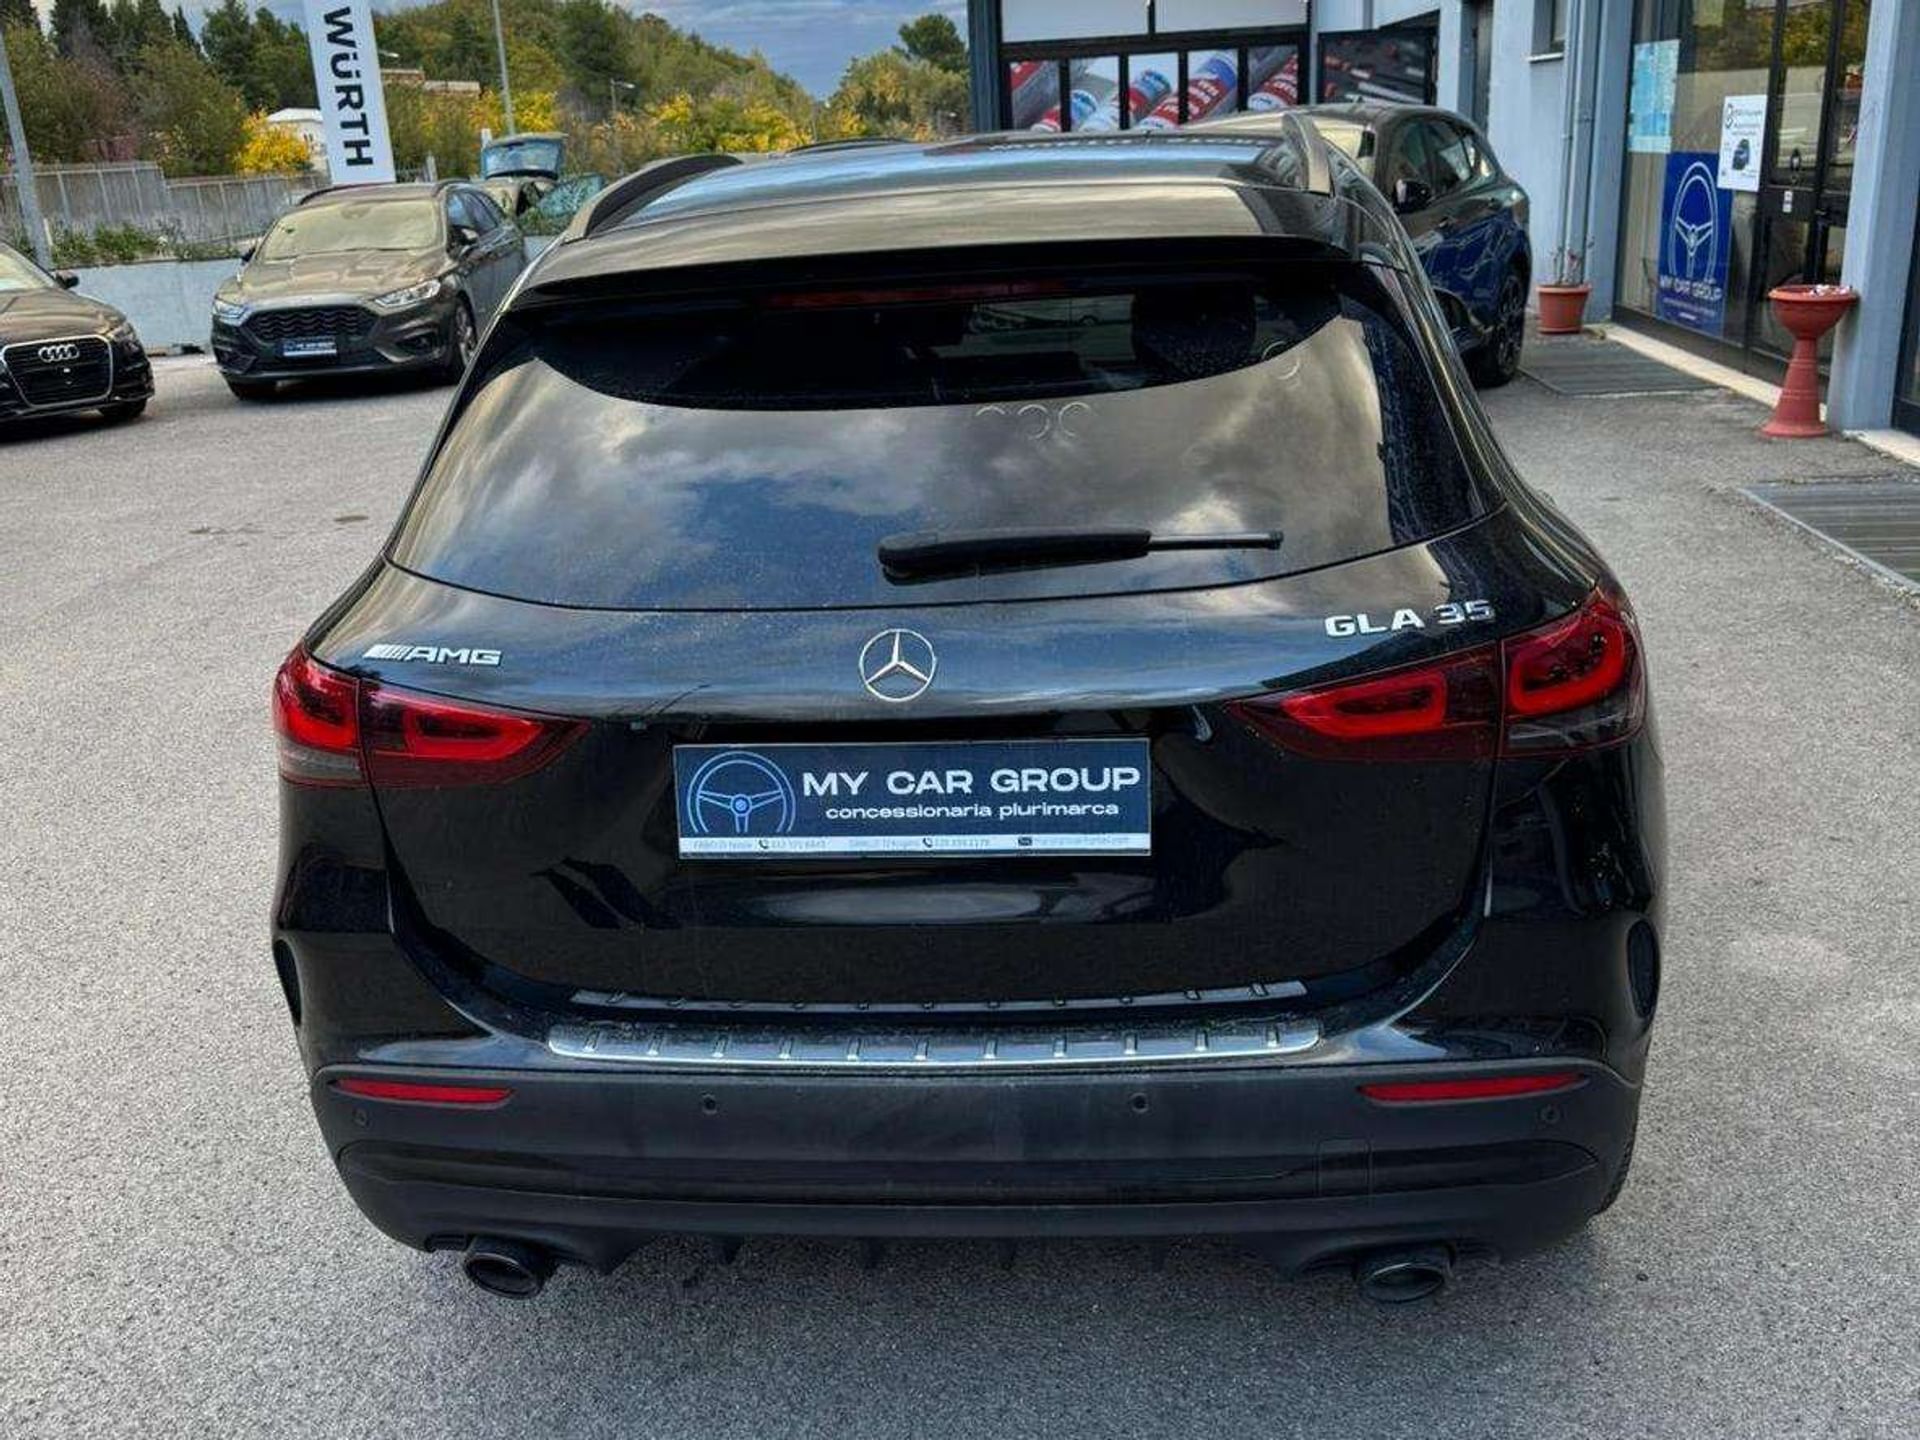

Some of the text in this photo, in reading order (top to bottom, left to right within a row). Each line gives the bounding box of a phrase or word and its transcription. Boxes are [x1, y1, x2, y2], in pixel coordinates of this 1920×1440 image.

[323, 6, 374, 167] WÜRTH
[1324, 599, 1495, 637] GLA 35
[404, 645, 502, 666] AMG
[802, 766, 1142, 797] MY CAR GROUP
[825, 801, 1119, 820] concessionaria plurimarca
